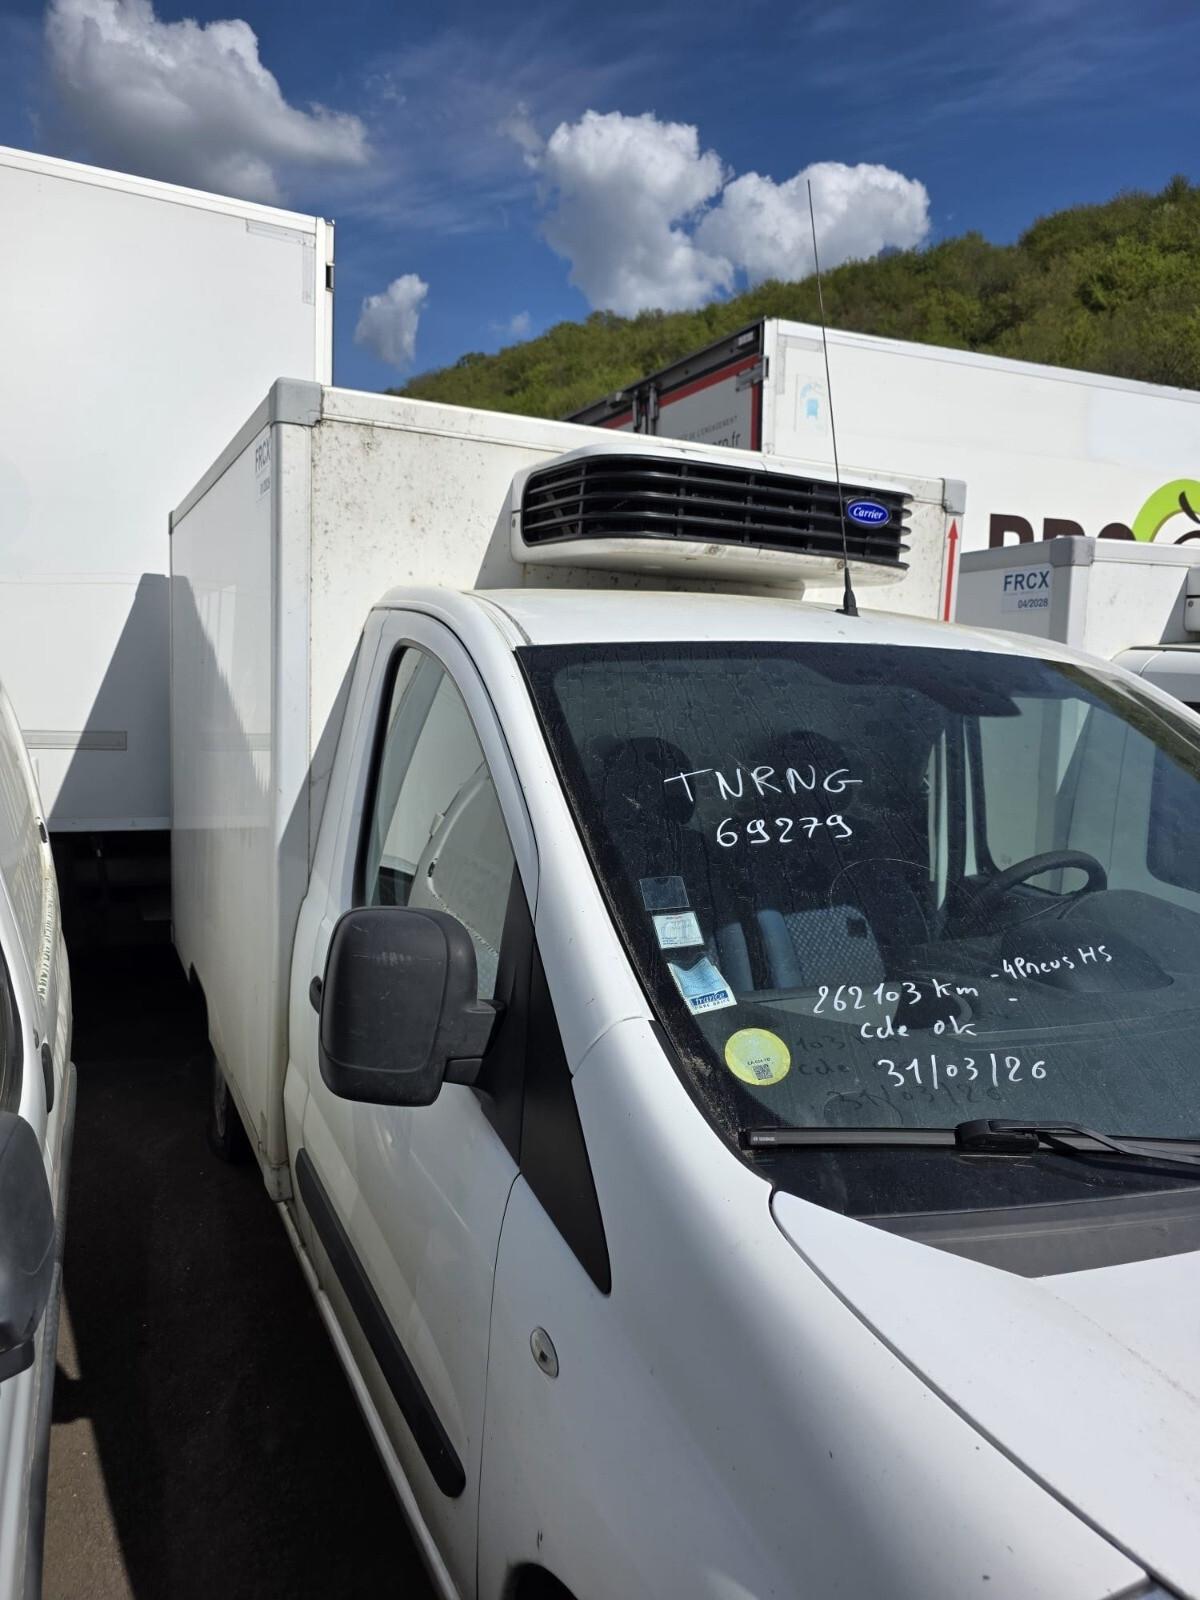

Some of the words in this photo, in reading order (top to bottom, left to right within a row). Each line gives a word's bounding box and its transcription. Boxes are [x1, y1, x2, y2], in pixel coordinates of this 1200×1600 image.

[853, 507, 884, 519] Carrier
[1003, 570, 1050, 592] FRCX
[663, 764, 864, 802] TNRNG
[716, 814, 853, 847] 69279
[1078, 945, 1113, 964] HS
